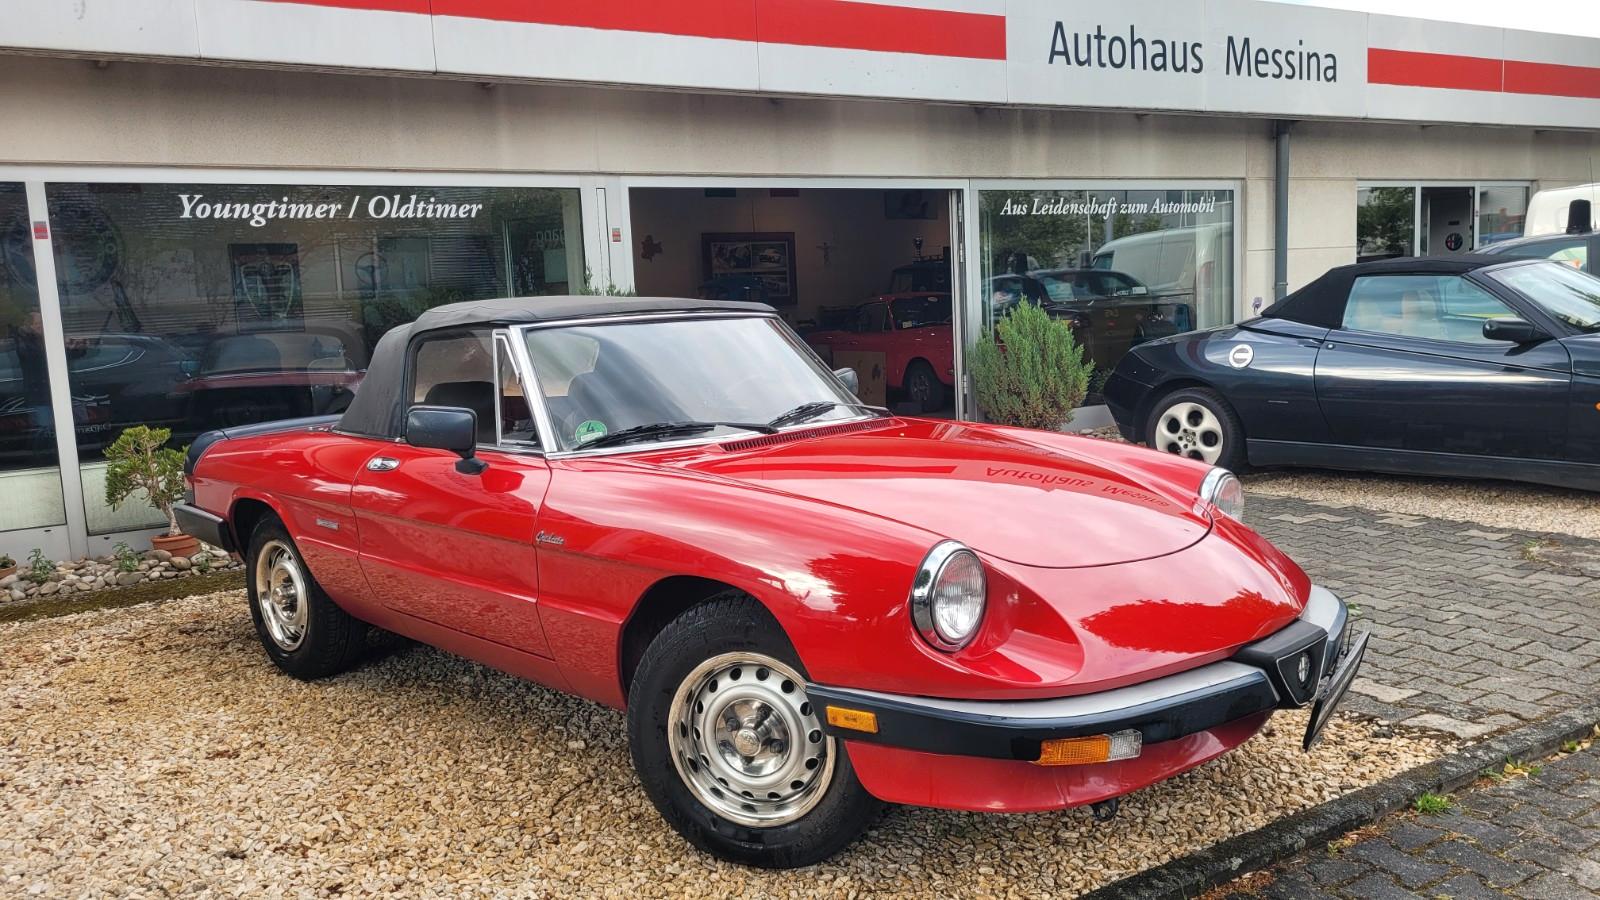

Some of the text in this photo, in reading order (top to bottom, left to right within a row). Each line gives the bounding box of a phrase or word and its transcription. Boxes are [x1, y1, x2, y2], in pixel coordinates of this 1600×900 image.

[1049, 21, 1337, 83] Autohaus Messina
[178, 194, 483, 227] Youngtimer / Oldtimer
[1000, 197, 1216, 220] Aus Leidenschaft zum Automobil
